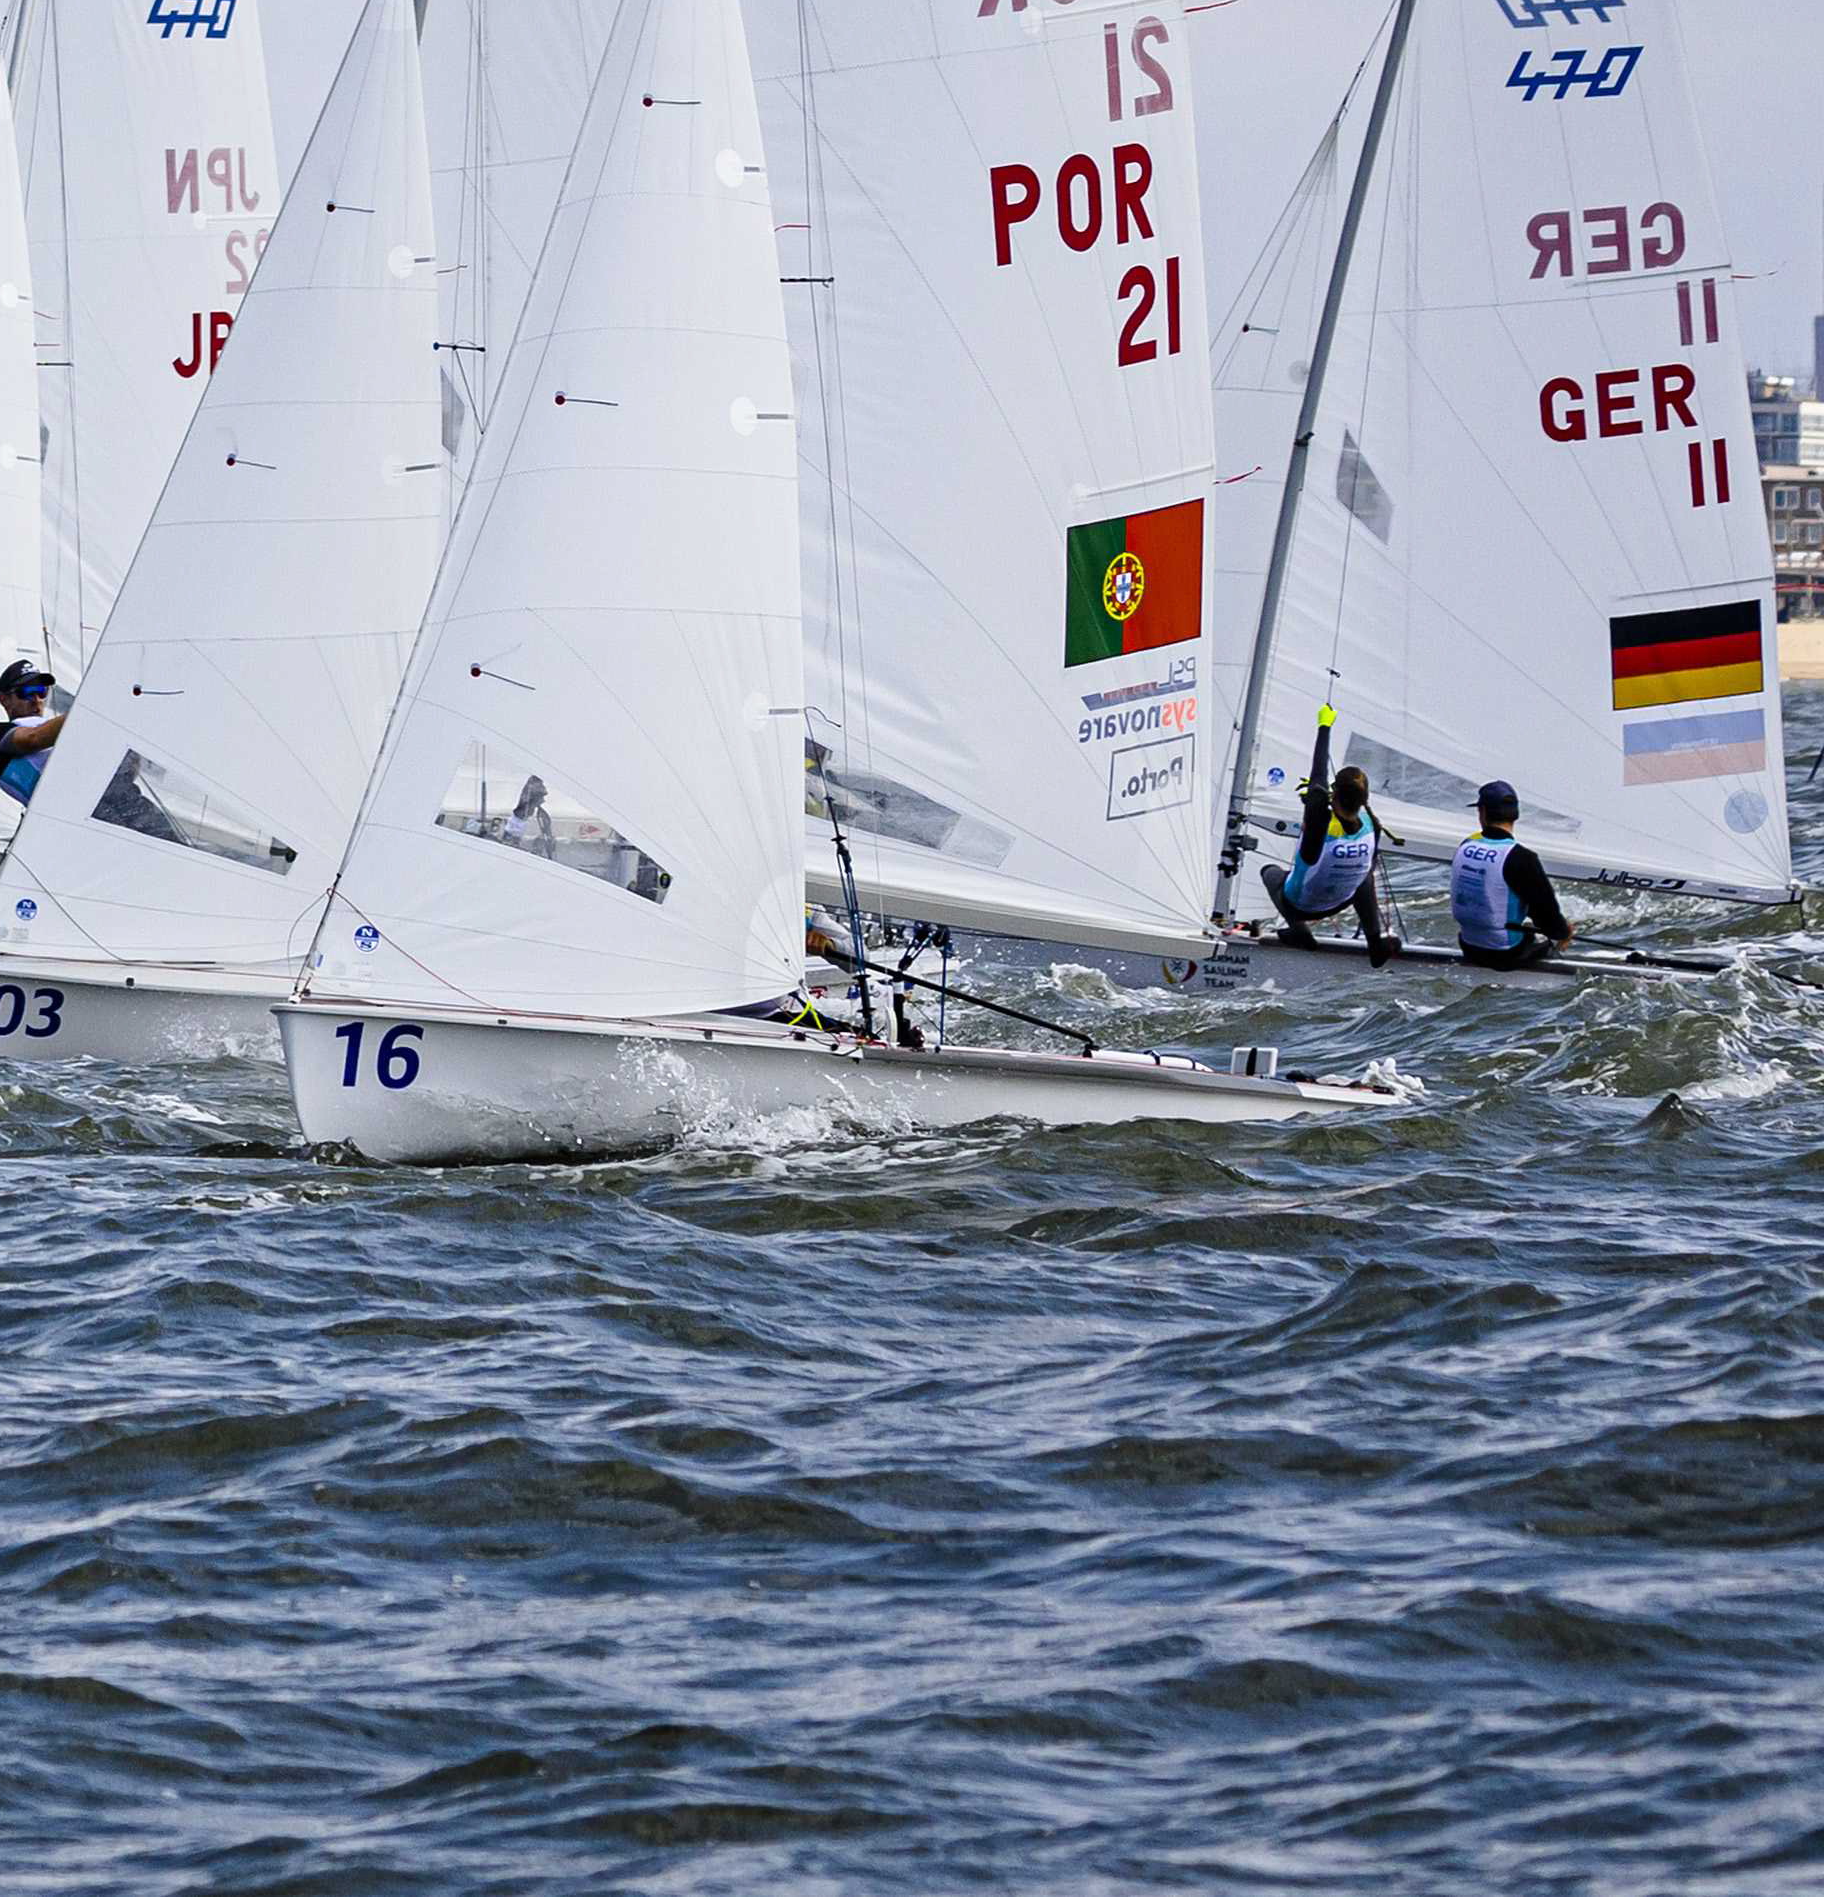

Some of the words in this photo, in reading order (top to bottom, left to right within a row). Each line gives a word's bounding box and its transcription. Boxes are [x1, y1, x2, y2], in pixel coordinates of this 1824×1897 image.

[1505, 45, 1643, 101] 470
[990, 142, 1155, 267] POR
[172, 311, 235, 379] JP
[1118, 256, 1182, 367] 21
[1539, 363, 1698, 442] GER
[1688, 438, 1731, 507] 11
[1333, 844, 1369, 859] GER
[1463, 845, 1498, 863] GER
[1588, 868, 1654, 888] Julbo
[334, 1021, 425, 1089] 16
